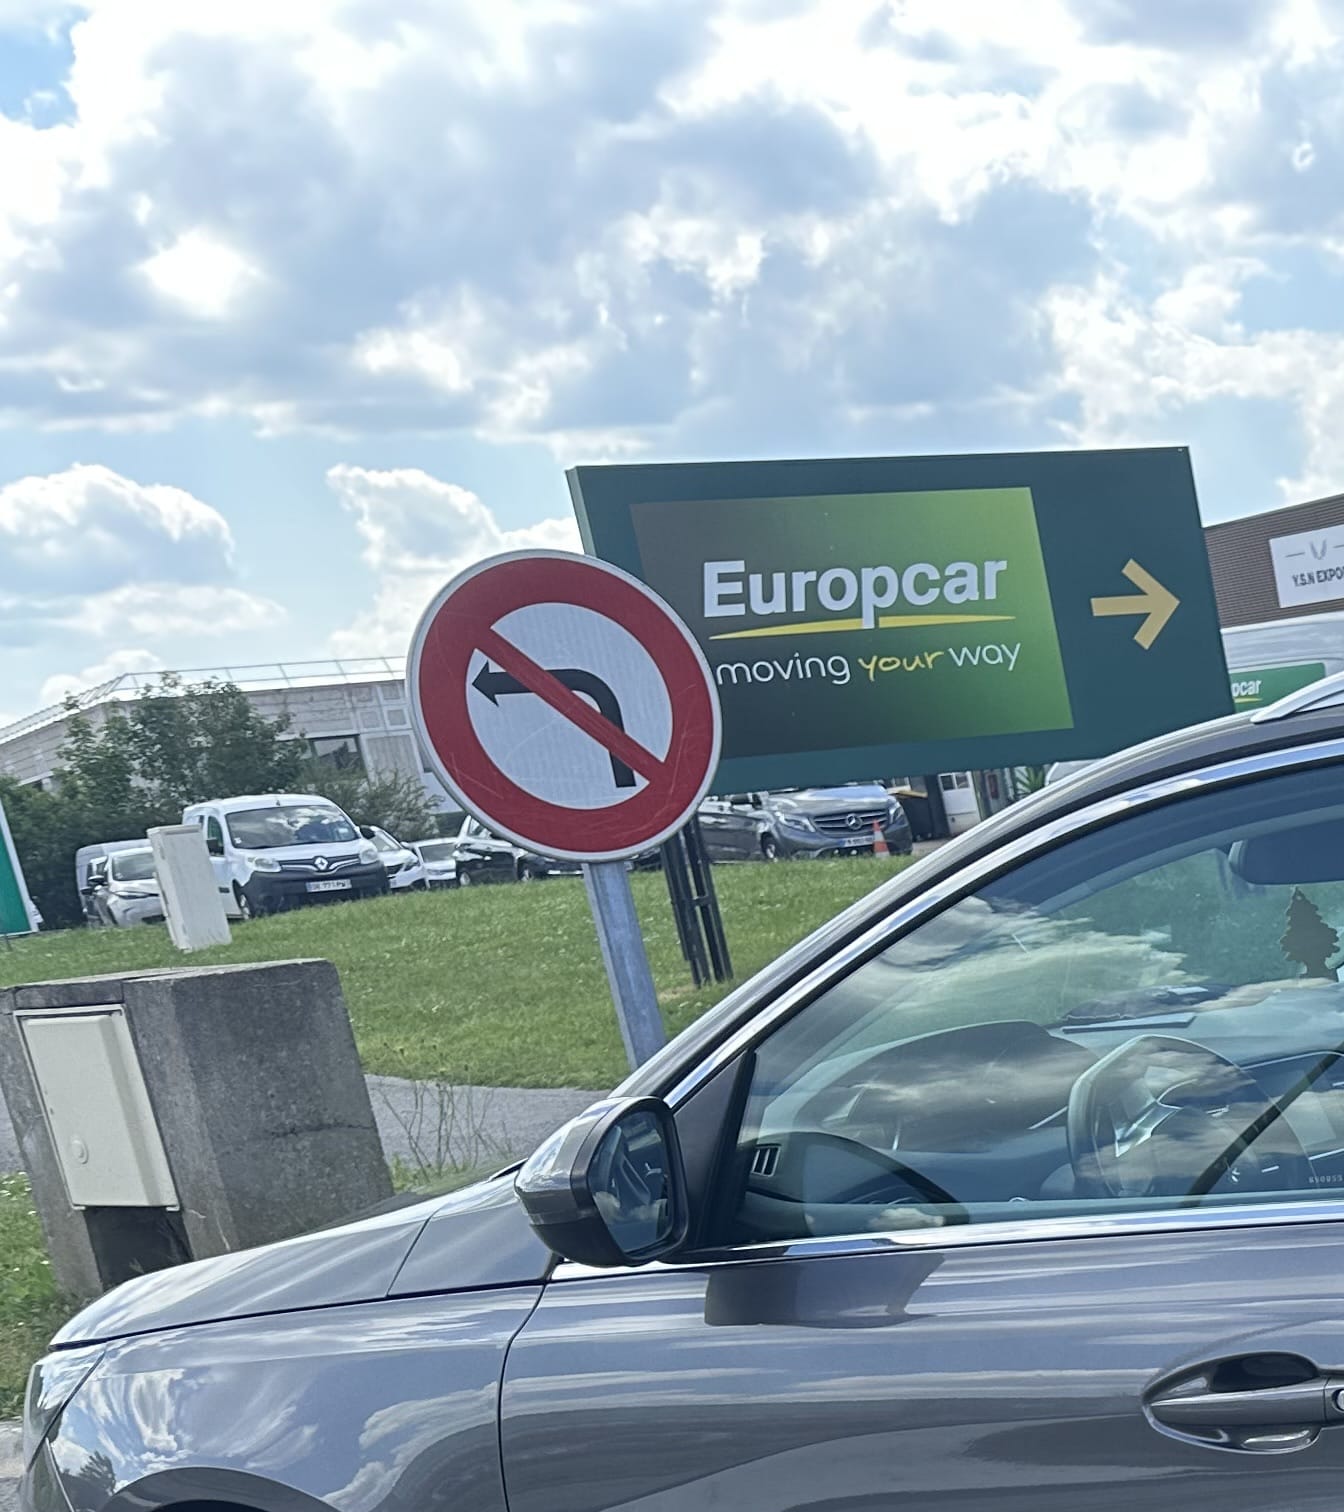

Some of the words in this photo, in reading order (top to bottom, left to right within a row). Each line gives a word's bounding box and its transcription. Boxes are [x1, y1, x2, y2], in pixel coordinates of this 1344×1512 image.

[702, 558, 1008, 630] Europcar
[715, 650, 852, 686] moving
[858, 649, 944, 681] your
[948, 641, 1022, 672] way
